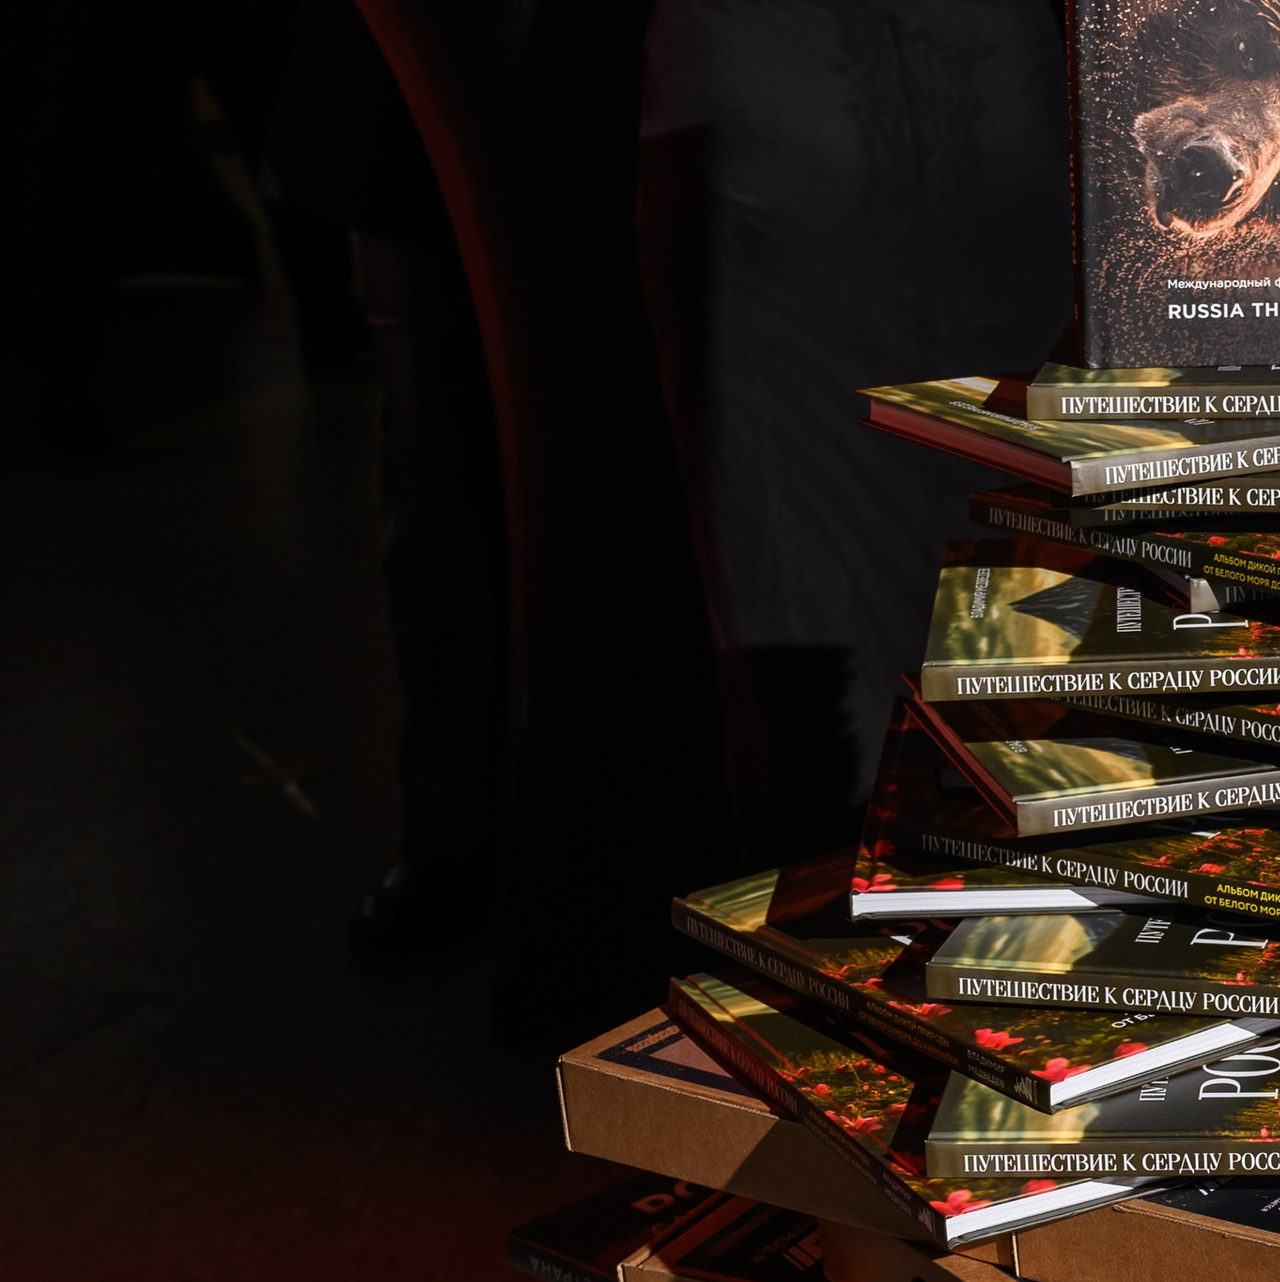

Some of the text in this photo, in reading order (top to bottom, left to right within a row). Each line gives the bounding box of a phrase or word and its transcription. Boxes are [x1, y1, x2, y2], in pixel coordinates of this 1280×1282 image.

[1167, 275, 1271, 291] Международный
[1167, 303, 1245, 320] RUSSIA
[1061, 396, 1200, 414] ПУТЕШЕСТВИЕ
[1204, 396, 1218, 413] К
[1084, 488, 1223, 506] ПУТЕШЕСТВИЕ
[1228, 488, 1241, 506] К
[1116, 587, 1142, 633] ПУТЕШЕСТ
[957, 673, 1103, 695] ПУТЕШЕСТВИЕ
[1108, 673, 1122, 690] К
[1128, 670, 1204, 691] СЕРДЦУ
[922, 833, 1189, 898] ПУТЕШЕСТВИЕ К СЕРДЦУ РОССИИ
[958, 977, 1279, 1015] ПУТЕШЕСТВИЕ К СЕРДЦУ РОССИИ
[964, 1154, 1118, 1172] ПУТЕШЕСТВИЕ
[1123, 1153, 1137, 1171] К
[1142, 1153, 1223, 1175] СЕРДЦУ
